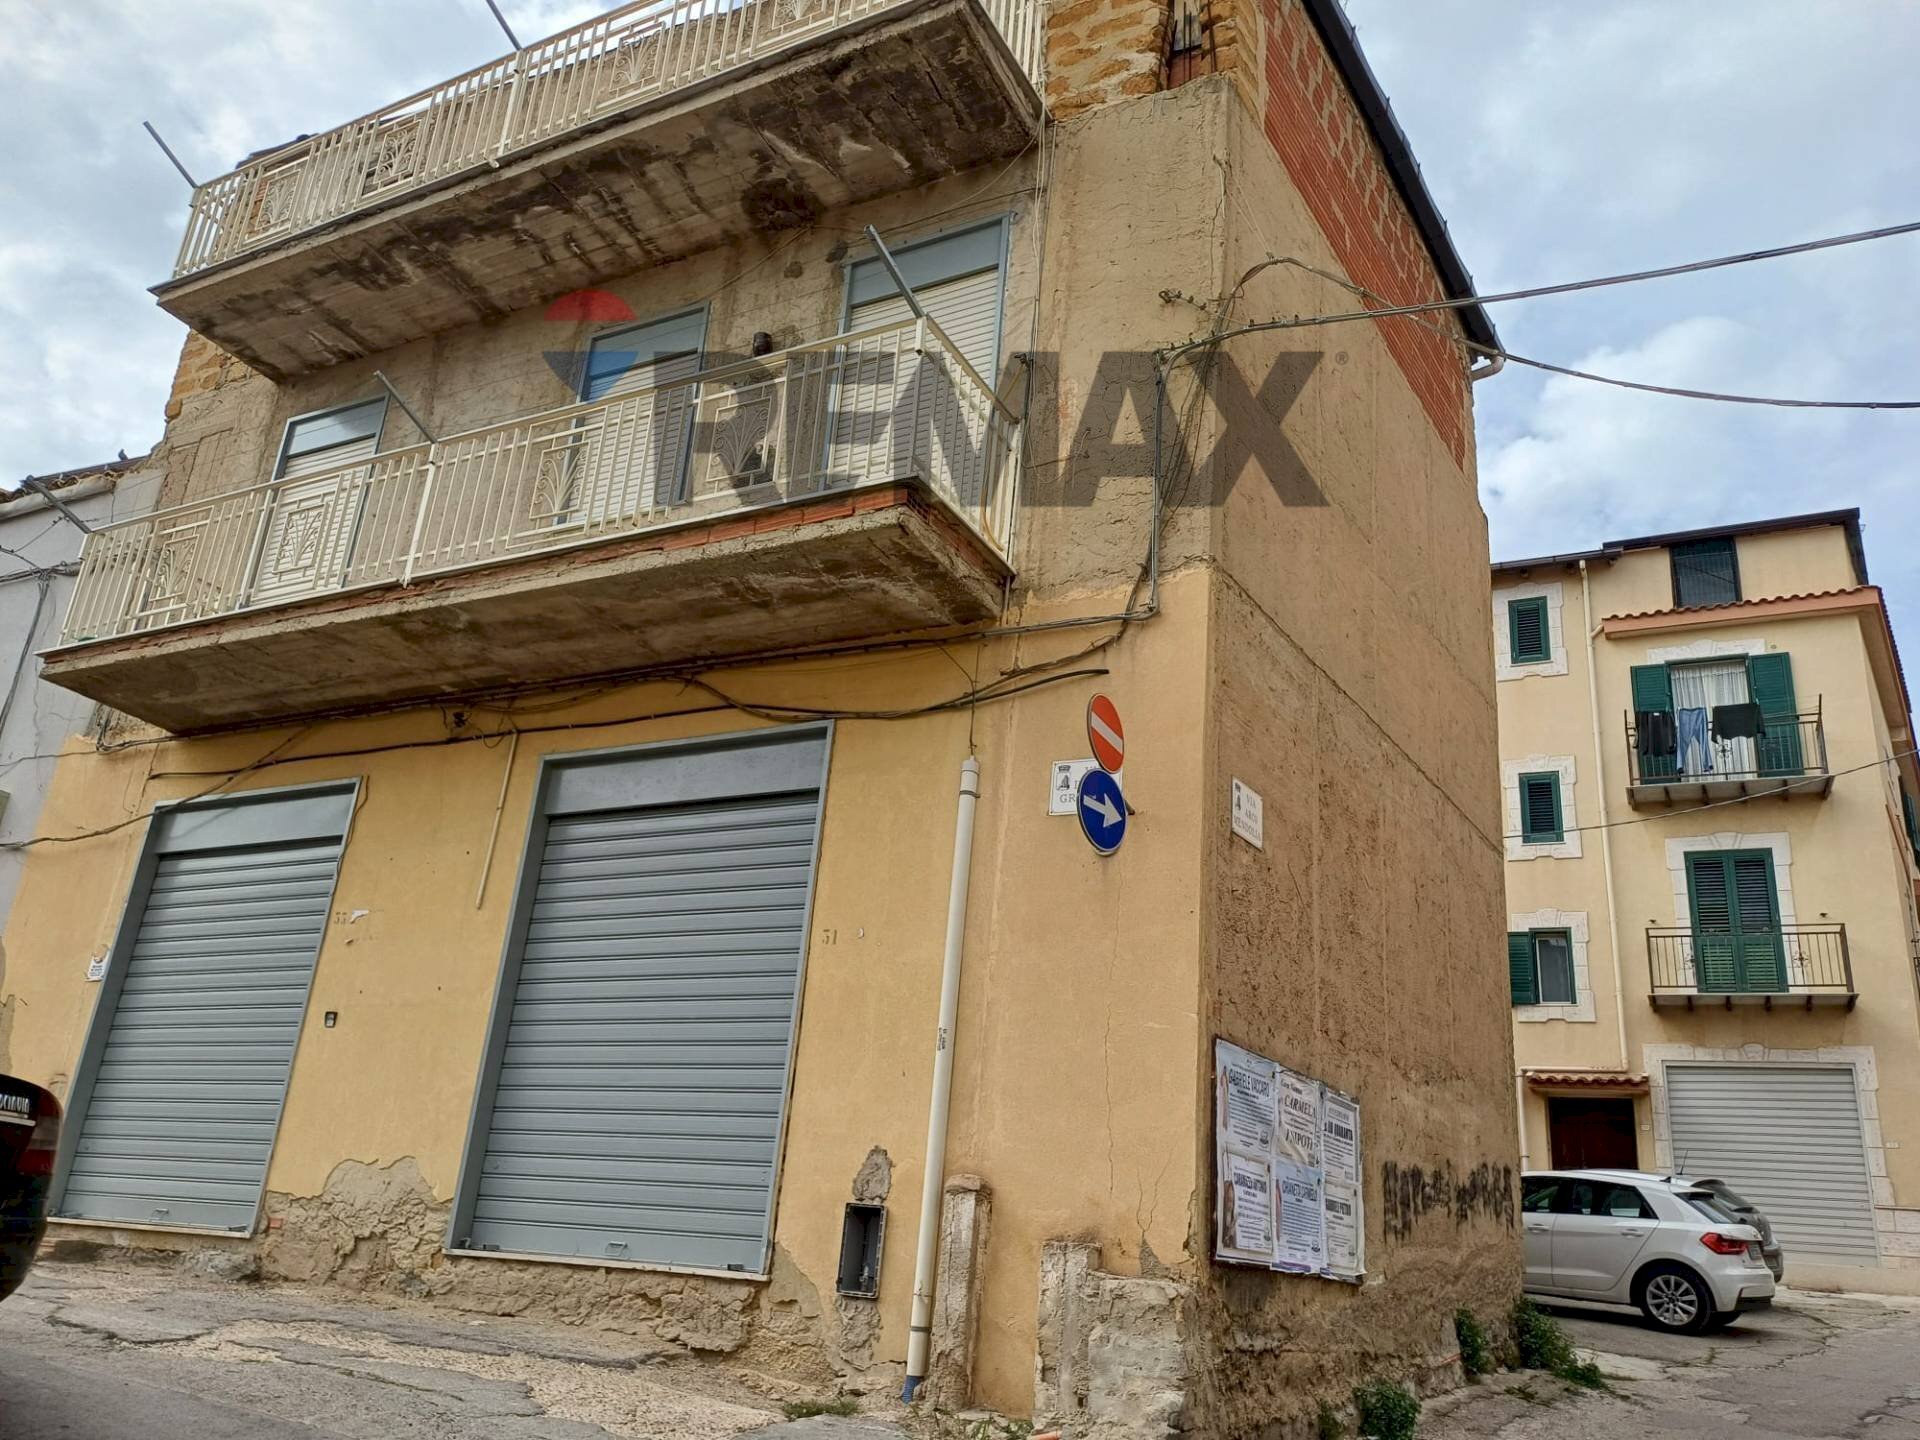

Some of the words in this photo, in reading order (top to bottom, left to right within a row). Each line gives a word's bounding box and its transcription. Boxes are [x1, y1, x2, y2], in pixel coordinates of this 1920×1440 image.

[1246, 793, 1257, 809] VIA
[1229, 1068, 1251, 1091] GABRIELE
[1250, 1077, 1270, 1098] VACCARO
[1284, 1094, 1316, 1119] CARMELA
